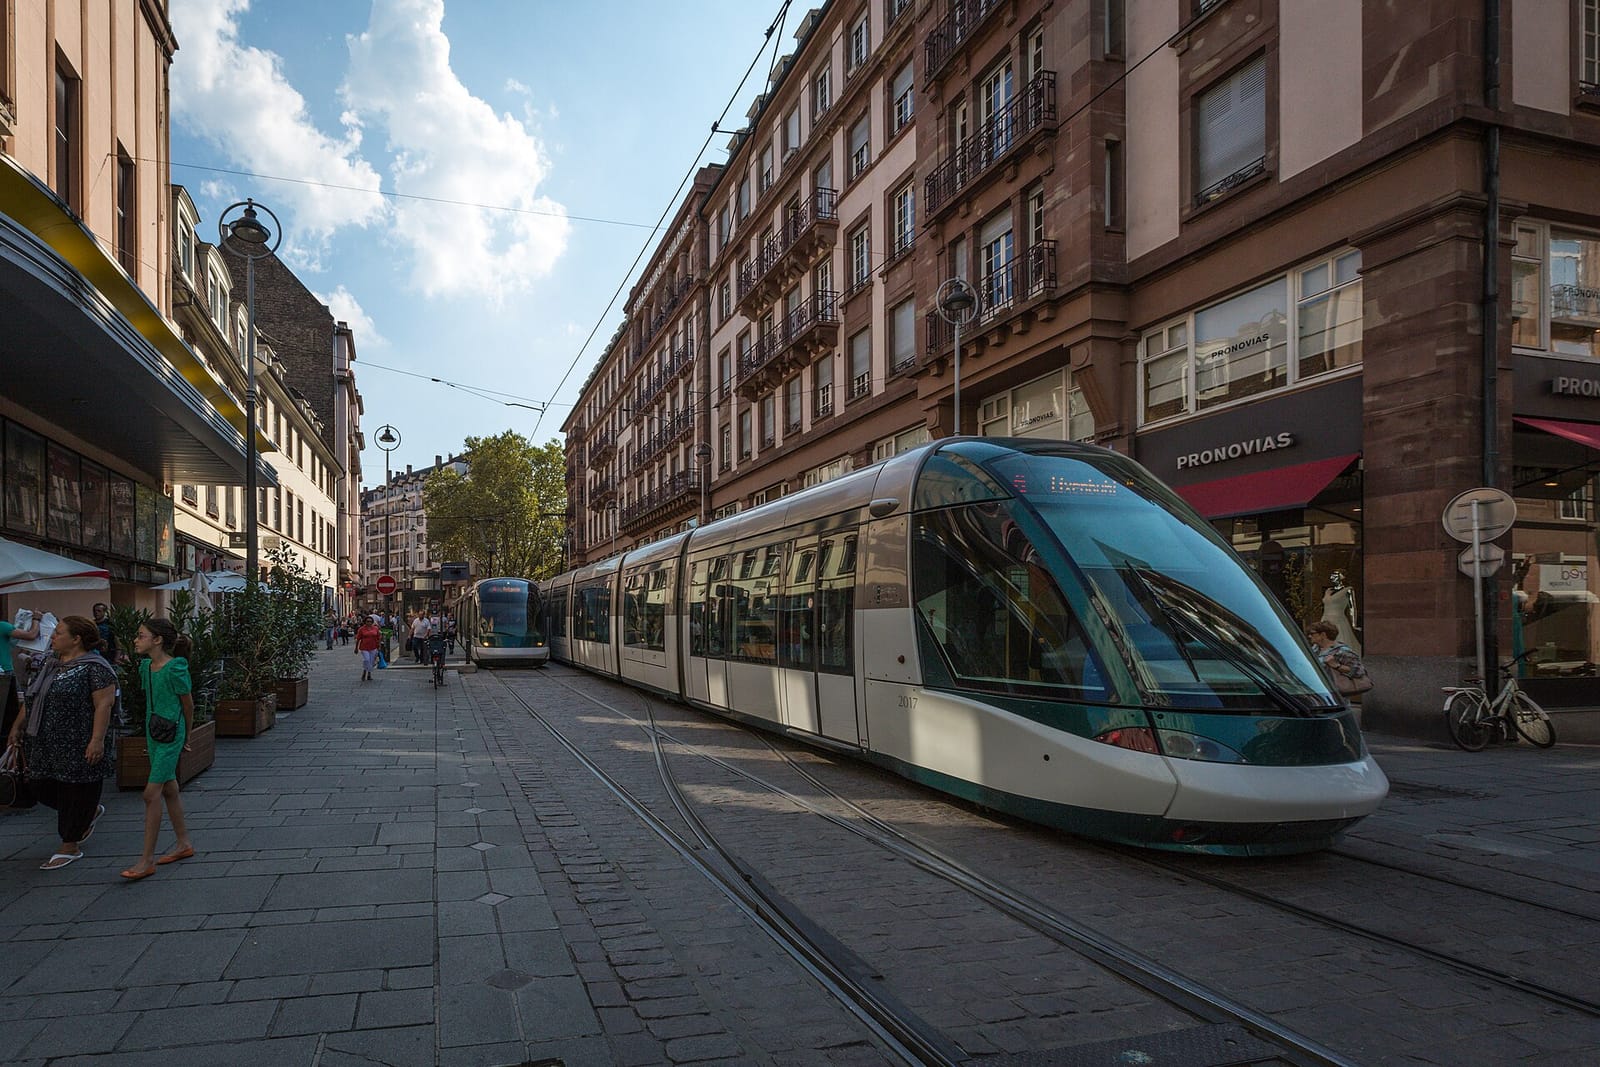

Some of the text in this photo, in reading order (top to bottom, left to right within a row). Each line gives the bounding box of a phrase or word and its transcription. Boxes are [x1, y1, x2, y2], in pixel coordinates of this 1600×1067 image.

[1211, 333, 1270, 359] PRONOVIAS
[1176, 432, 1291, 470] PRONOVIAS
[898, 695, 918, 710] 2017
